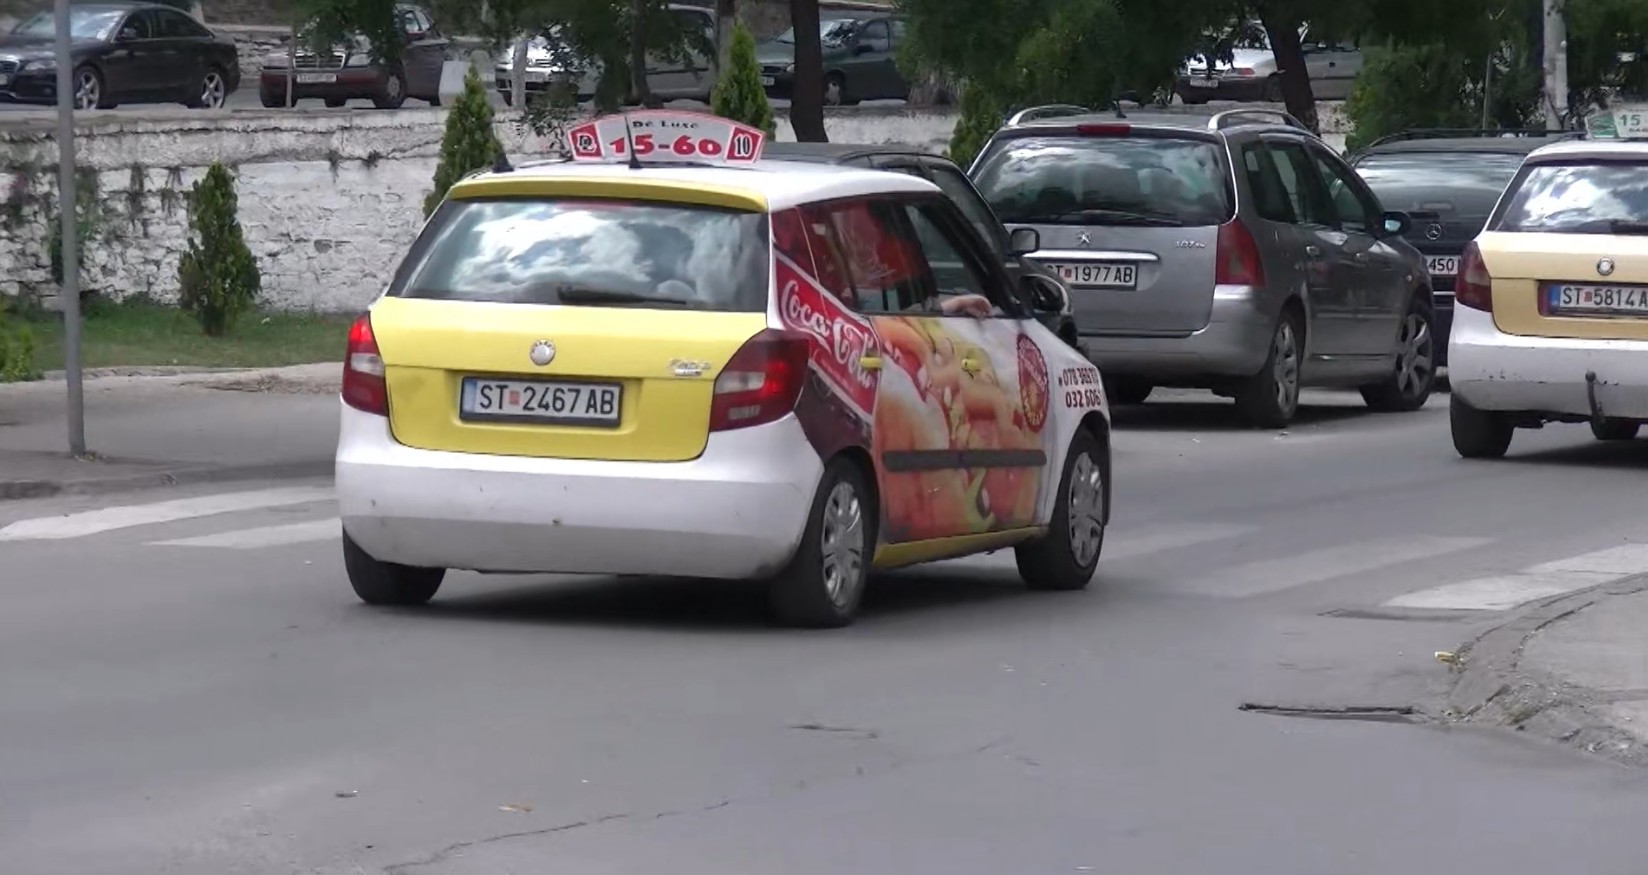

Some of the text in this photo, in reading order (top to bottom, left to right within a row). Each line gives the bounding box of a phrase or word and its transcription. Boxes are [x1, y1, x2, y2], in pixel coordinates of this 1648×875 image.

[609, 134, 722, 156] 15-60
[735, 135, 750, 156] 10
[1562, 287, 1583, 305] ST
[479, 384, 509, 409] ST
[1065, 390, 1084, 408] 032
